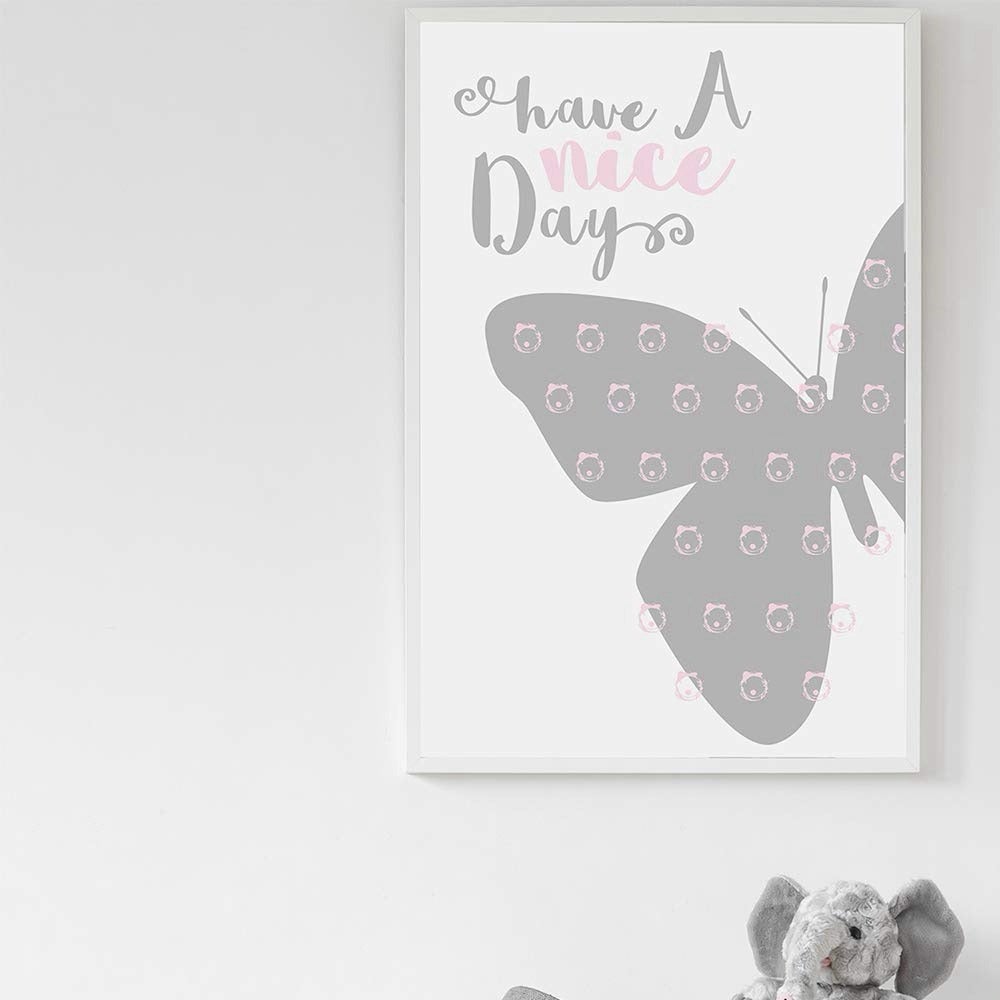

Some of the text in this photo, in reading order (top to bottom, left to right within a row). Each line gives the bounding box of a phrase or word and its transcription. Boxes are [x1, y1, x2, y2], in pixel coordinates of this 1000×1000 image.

[454, 50, 752, 140] have A
[539, 131, 736, 197] nice
[472, 152, 695, 282] Day
